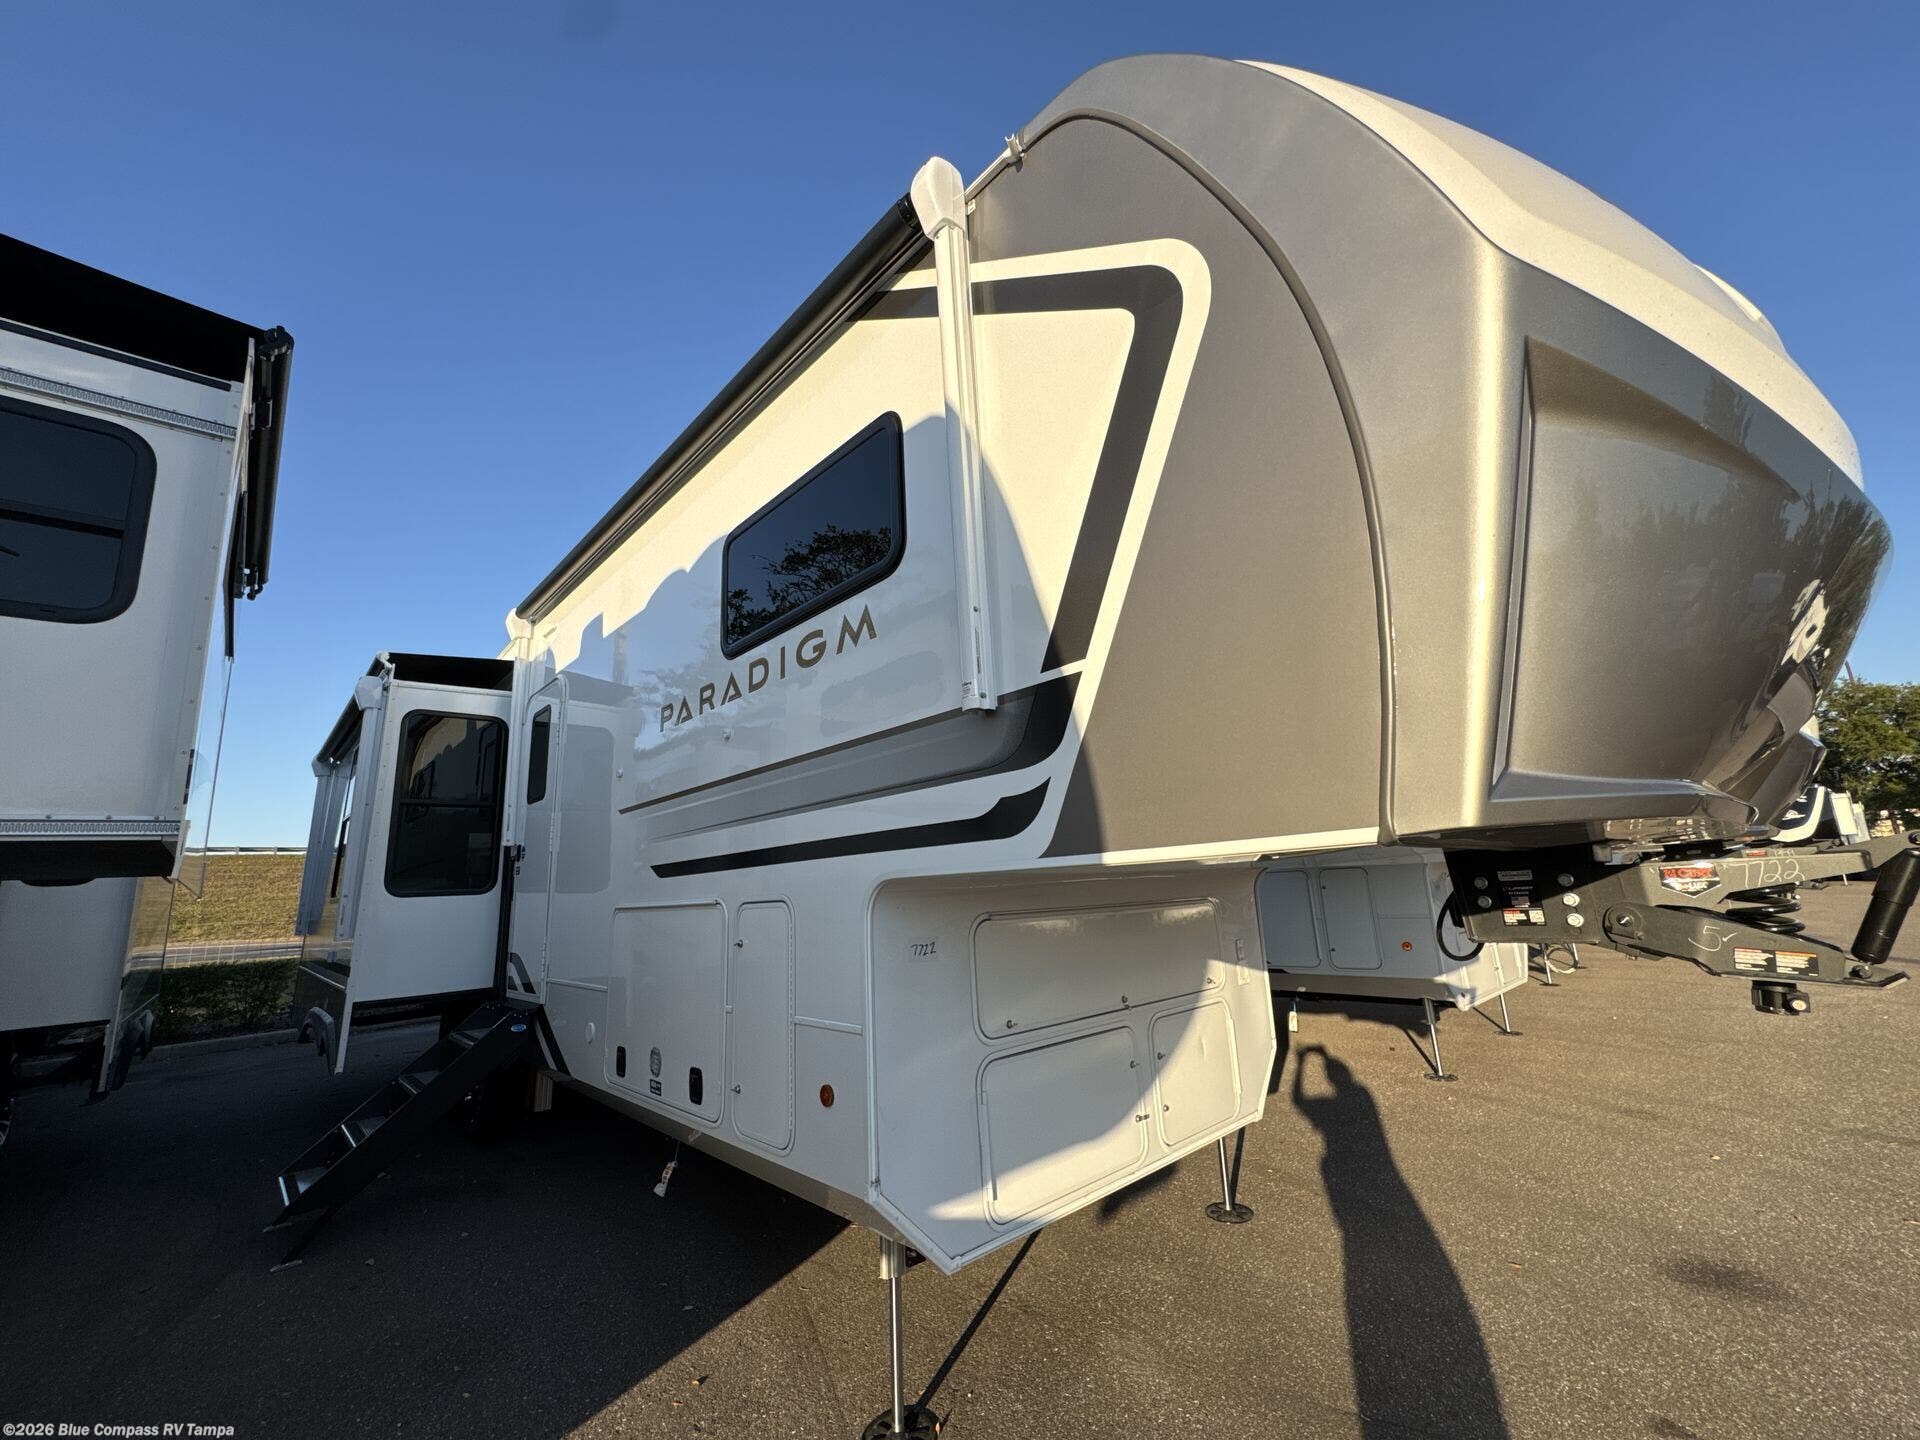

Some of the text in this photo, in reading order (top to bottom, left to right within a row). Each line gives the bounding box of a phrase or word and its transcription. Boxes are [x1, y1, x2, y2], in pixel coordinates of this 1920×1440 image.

[660, 604, 878, 733] PARADIGM
[1726, 858, 1806, 889] 7722
[910, 941, 937, 956] 7722
